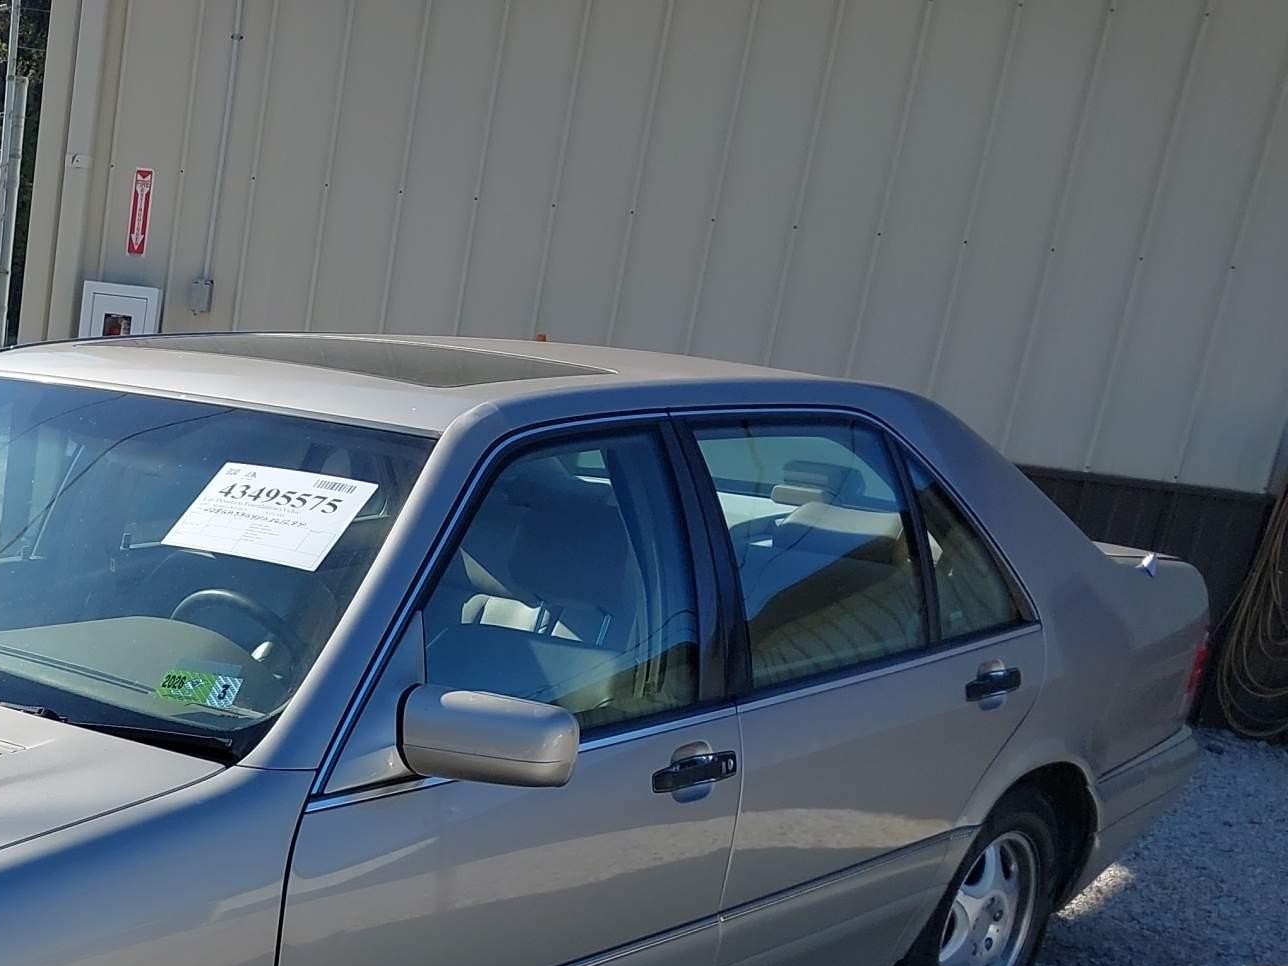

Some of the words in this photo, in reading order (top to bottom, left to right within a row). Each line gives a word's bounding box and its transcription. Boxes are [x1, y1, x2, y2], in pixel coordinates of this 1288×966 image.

[135, 180, 152, 188] FIRE
[218, 482, 344, 515] 43495575
[161, 674, 187, 689] 2026
[217, 683, 230, 700] 3
